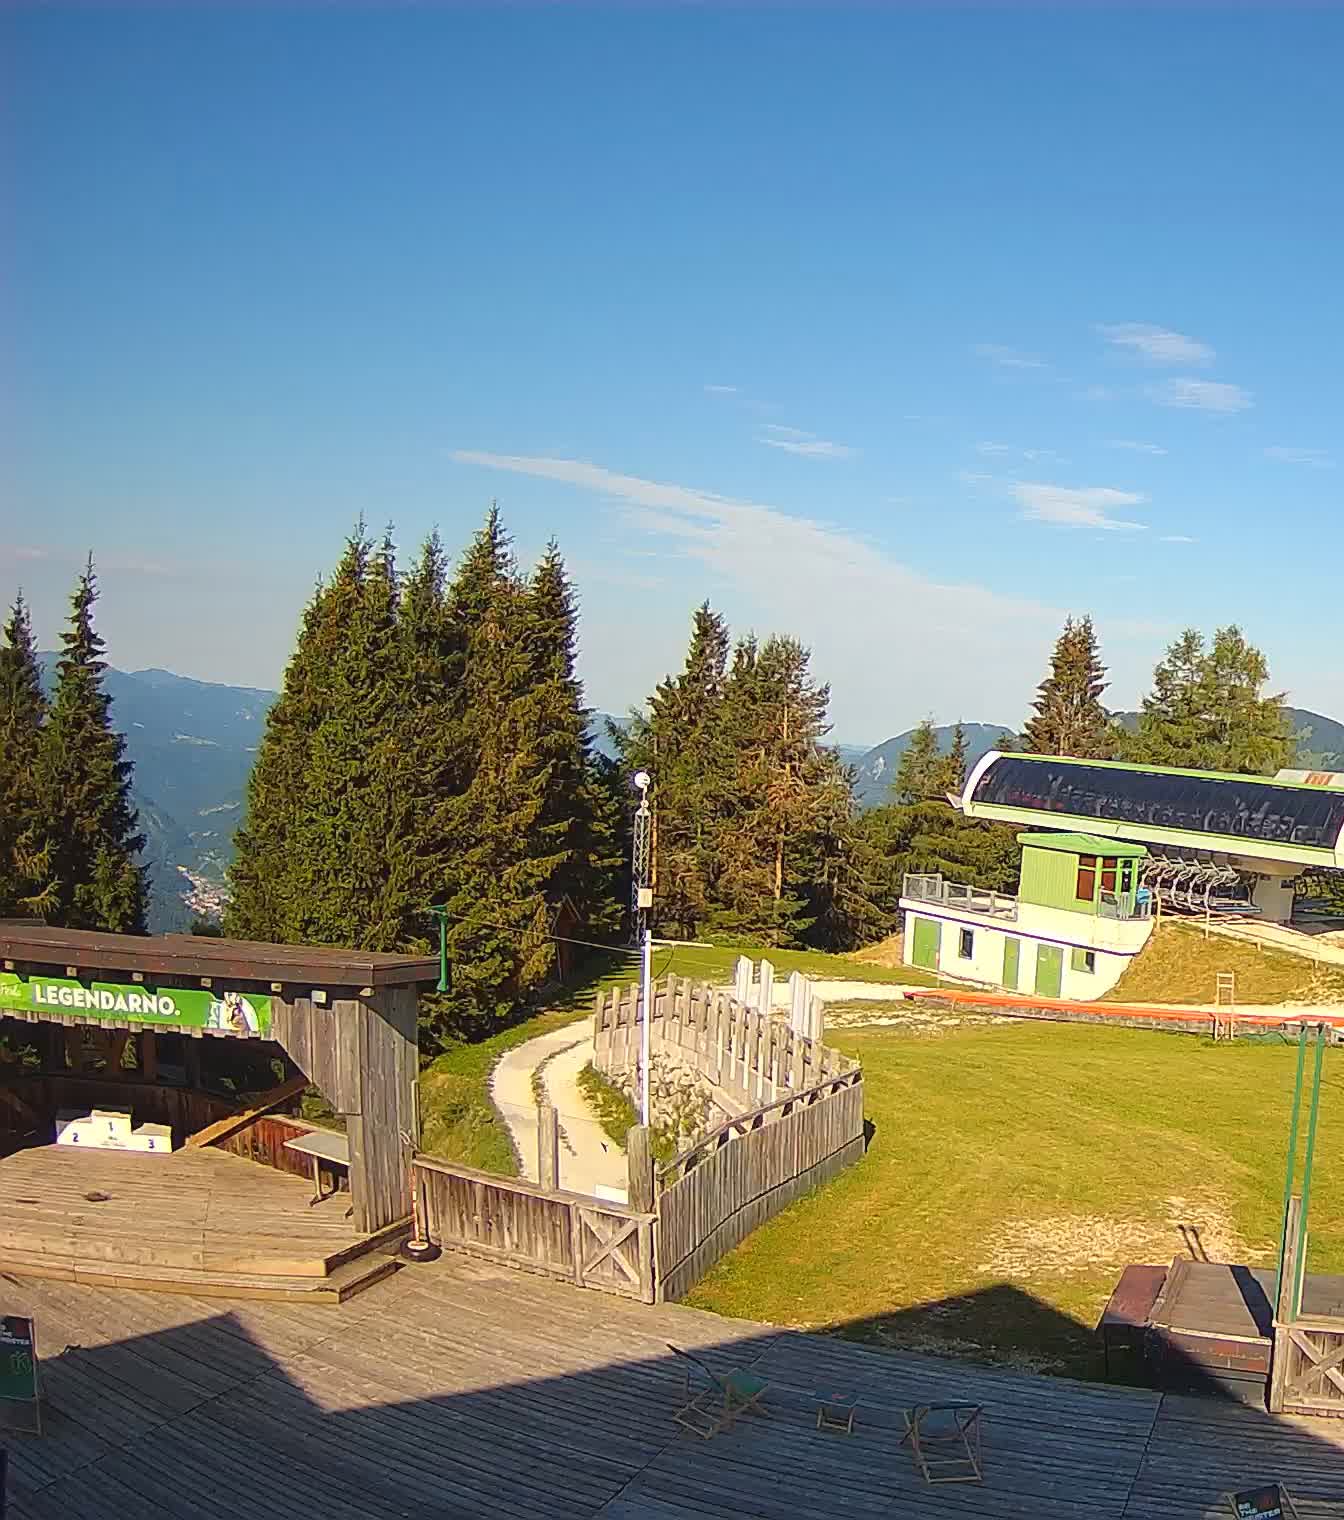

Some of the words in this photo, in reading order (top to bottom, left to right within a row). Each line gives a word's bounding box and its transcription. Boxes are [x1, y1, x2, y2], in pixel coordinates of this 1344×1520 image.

[34, 983, 181, 1016] LEGENDARNO.
[73, 1132, 79, 1143] 2
[148, 1138, 155, 1149] 3
